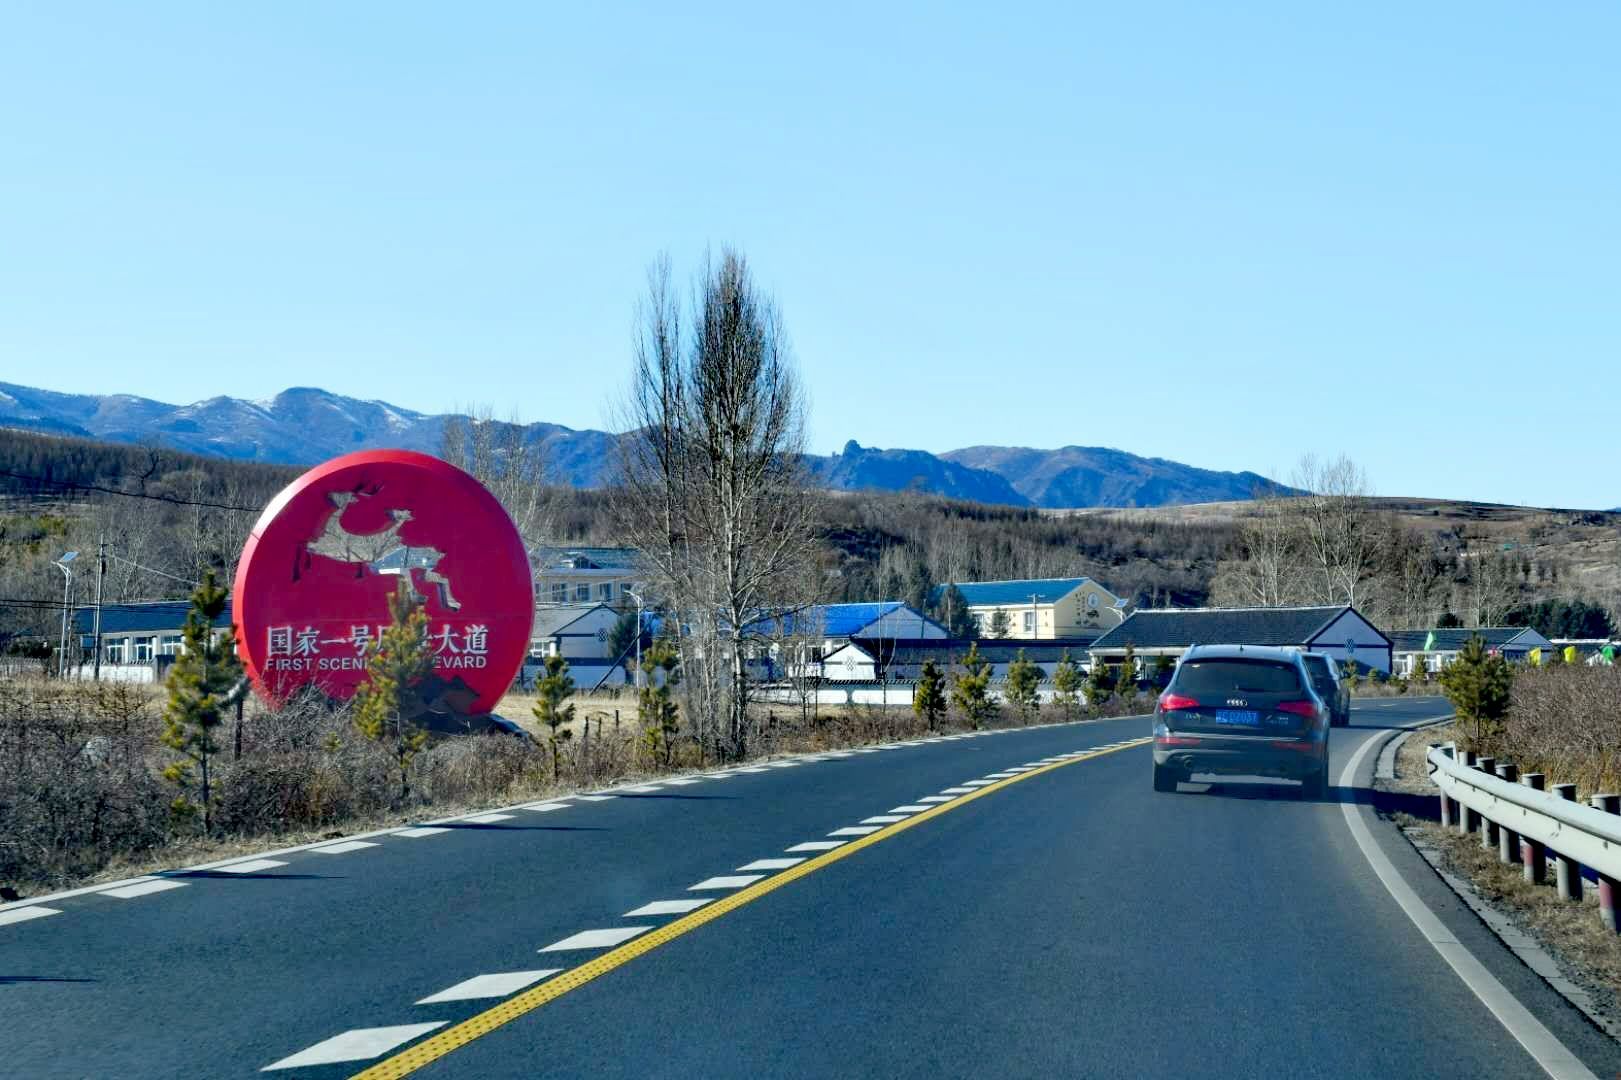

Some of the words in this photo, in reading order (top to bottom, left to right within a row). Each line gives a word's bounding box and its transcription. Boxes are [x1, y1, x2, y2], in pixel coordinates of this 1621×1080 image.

[266, 624, 489, 656] 国家一号大道
[264, 658, 312, 671] FIRST
[319, 657, 376, 671] SCENI
